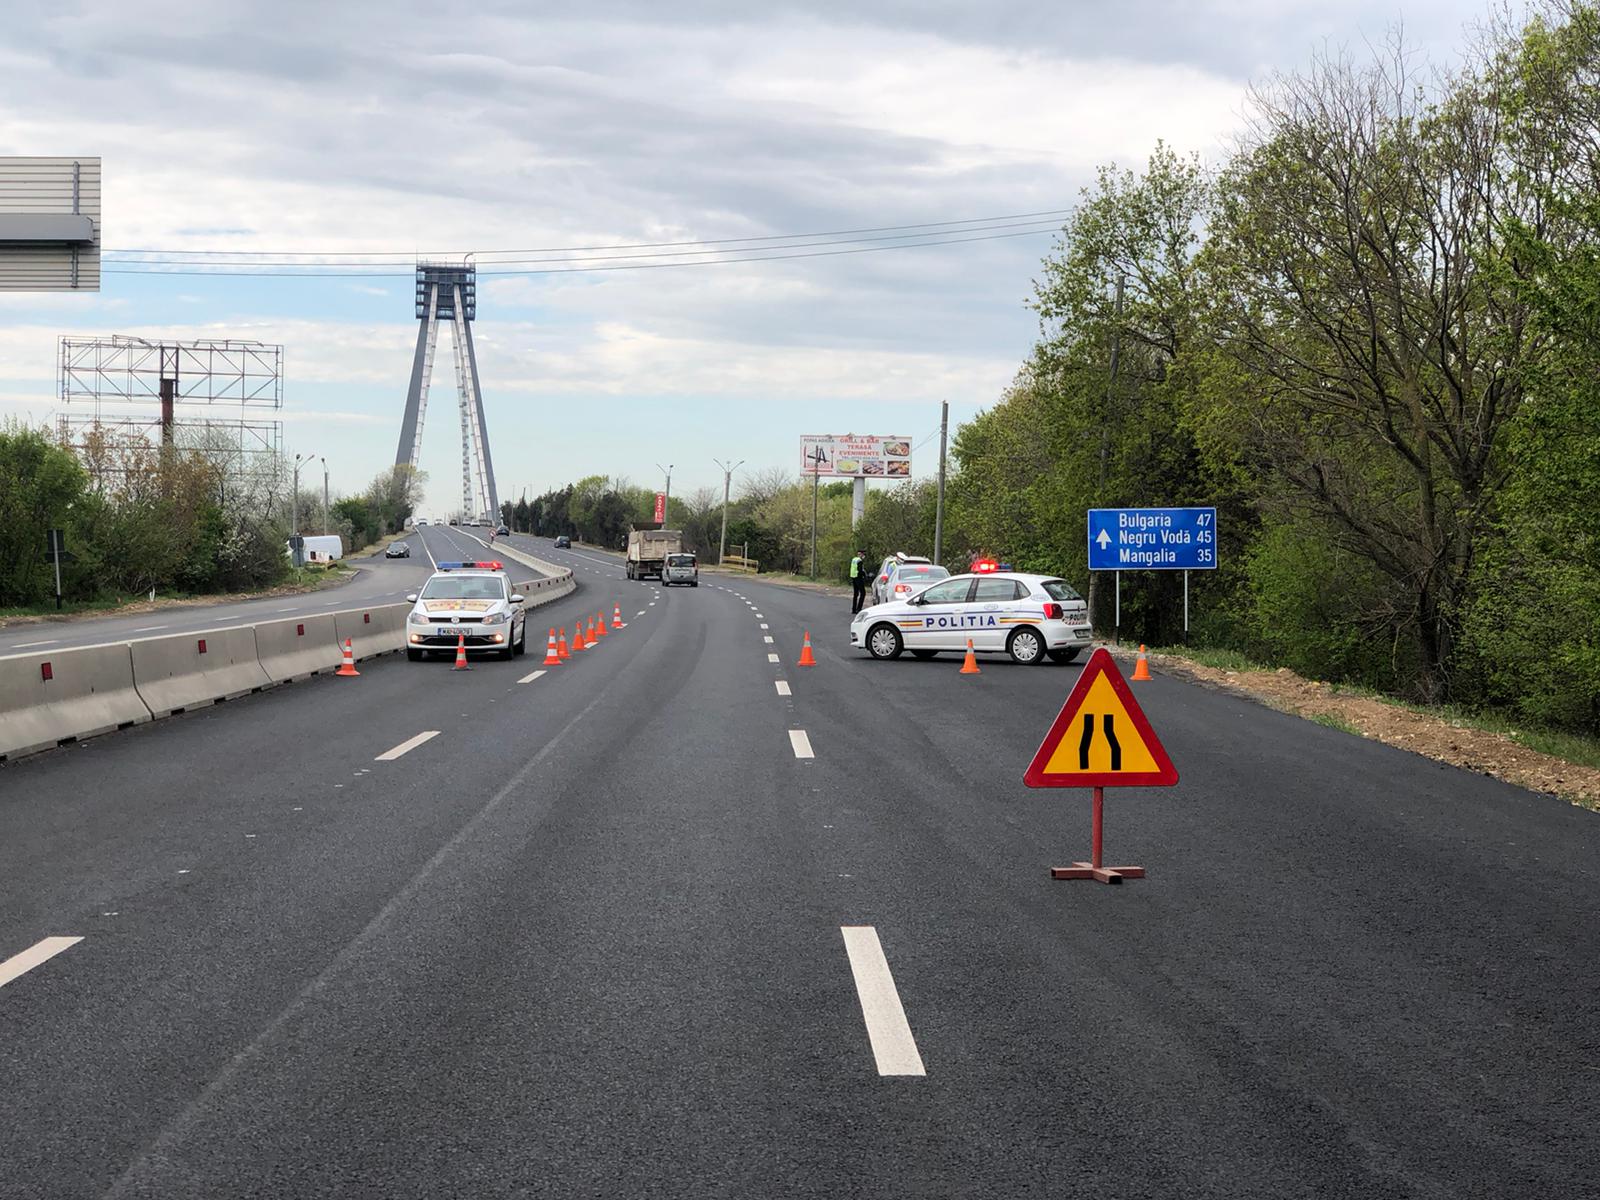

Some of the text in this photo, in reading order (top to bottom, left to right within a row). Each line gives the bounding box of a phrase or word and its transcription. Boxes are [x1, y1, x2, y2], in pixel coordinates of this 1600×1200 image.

[1119, 513, 1211, 531] Bulgaria 47
[1119, 531, 1155, 547] Negru
[1197, 531, 1211, 543] 45
[1119, 549, 1211, 566] Mangalia 35
[926, 615, 996, 628] POLITIA
